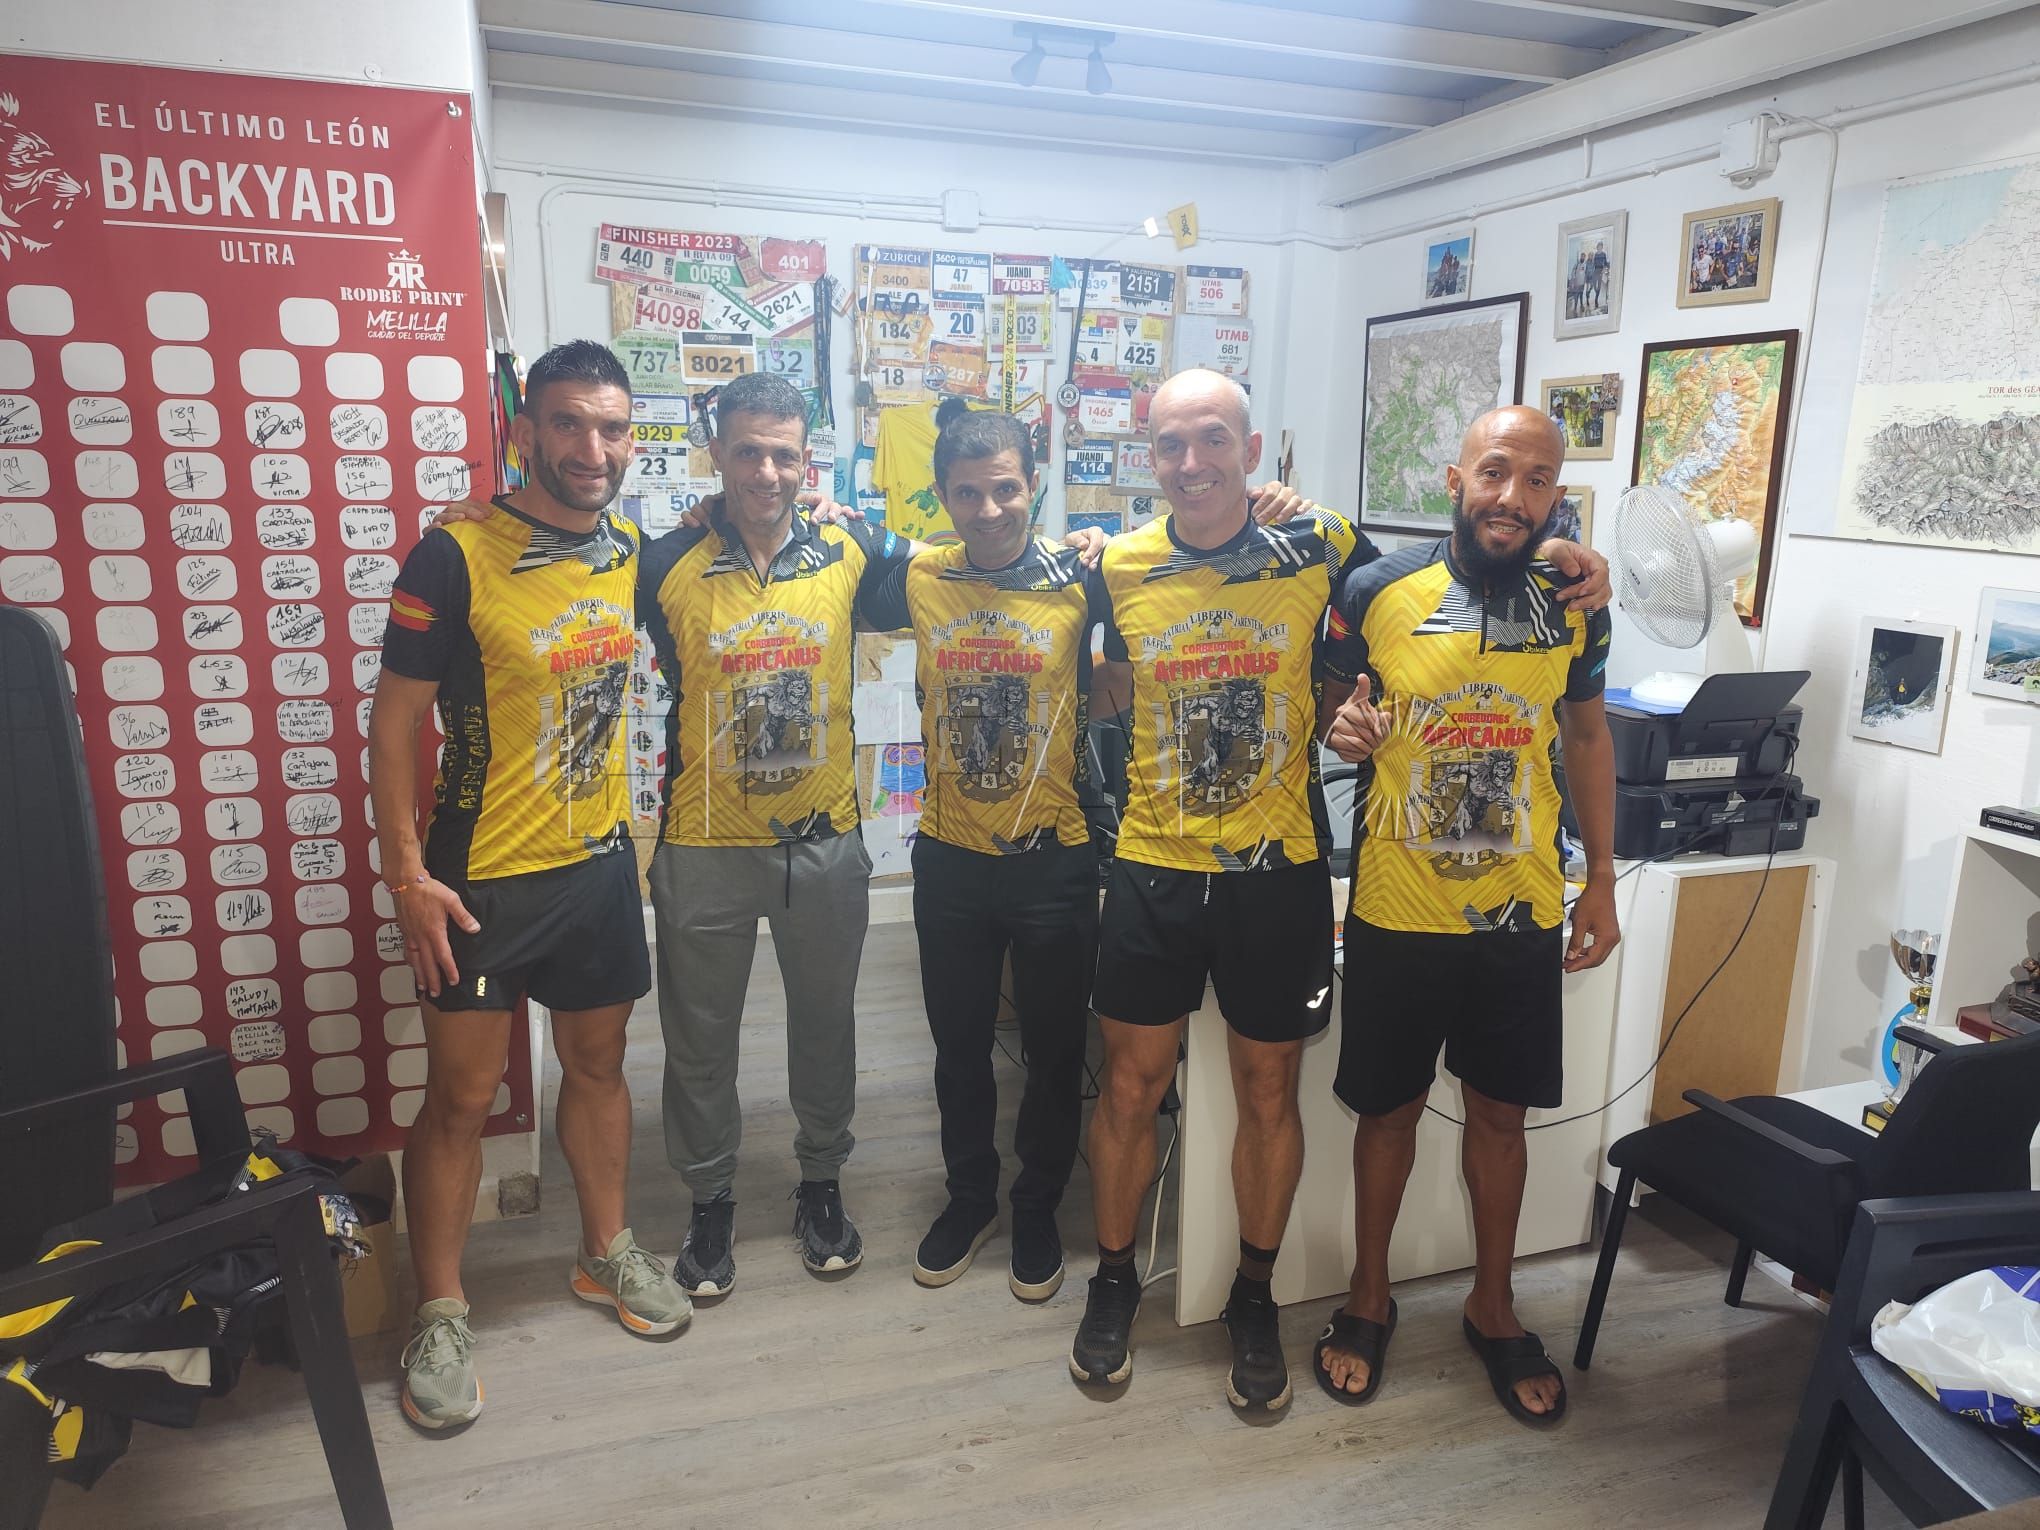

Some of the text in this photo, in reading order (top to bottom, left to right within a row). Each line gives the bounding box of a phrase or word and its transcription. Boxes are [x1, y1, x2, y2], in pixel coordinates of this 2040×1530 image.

[95, 100, 390, 149] EL ÚLTIMO LEÓN
[100, 152, 396, 226] BACKYARD
[612, 227, 733, 249] FINISHER 2023
[220, 239, 296, 267] ULTRA
[620, 246, 654, 269] 440
[779, 255, 809, 270] 401
[690, 265, 731, 285] 0059
[953, 268, 968, 282] 47
[1007, 266, 1031, 278] JUANDI
[882, 275, 909, 286] 3400
[1002, 279, 1044, 292] 7093
[1127, 274, 1160, 295] 2151
[340, 286, 465, 307] RODBE PRINT
[1200, 288, 1224, 299] 506
[763, 290, 803, 320] 2621
[366, 309, 448, 334] MELILLA
[641, 300, 700, 331] 4098
[721, 304, 750, 332] 144
[950, 312, 974, 335] 20
[367, 331, 446, 342] CIUDAD DEL DEPORTE
[880, 322, 911, 339] 184
[1215, 329, 1249, 341] UTMB
[1090, 347, 1099, 361] 4
[1124, 346, 1155, 366] 425
[1221, 344, 1240, 355] 681
[630, 350, 669, 373] 737
[691, 356, 745, 374] 8021
[881, 367, 905, 386] 18
[170, 407, 196, 420] 189
[1087, 406, 1114, 418] 1465
[637, 425, 673, 442] 929
[1077, 451, 1104, 462] JUANDI
[640, 457, 668, 476] 23
[1080, 462, 1106, 473] 114
[178, 505, 202, 517] 204
[269, 508, 294, 519] 133
[275, 558, 296, 570] 154
[276, 604, 302, 617] 169
[571, 598, 604, 613] LIBERIS
[751, 611, 785, 623] LIBERIS
[970, 611, 1008, 621] LIBERIS
[1190, 610, 1234, 624] LIBERIS
[1259, 624, 1286, 643] DECET
[721, 646, 822, 674] AFRICANUS
[936, 648, 1043, 673] AFRICANUS
[1154, 651, 1281, 683] AFRICANUS
[1463, 683, 1504, 694] LIBERIS
[1422, 724, 1535, 748] AFRICANUS
[145, 854, 171, 865] 113
[304, 865, 334, 878] 175
[230, 986, 246, 996] 143
